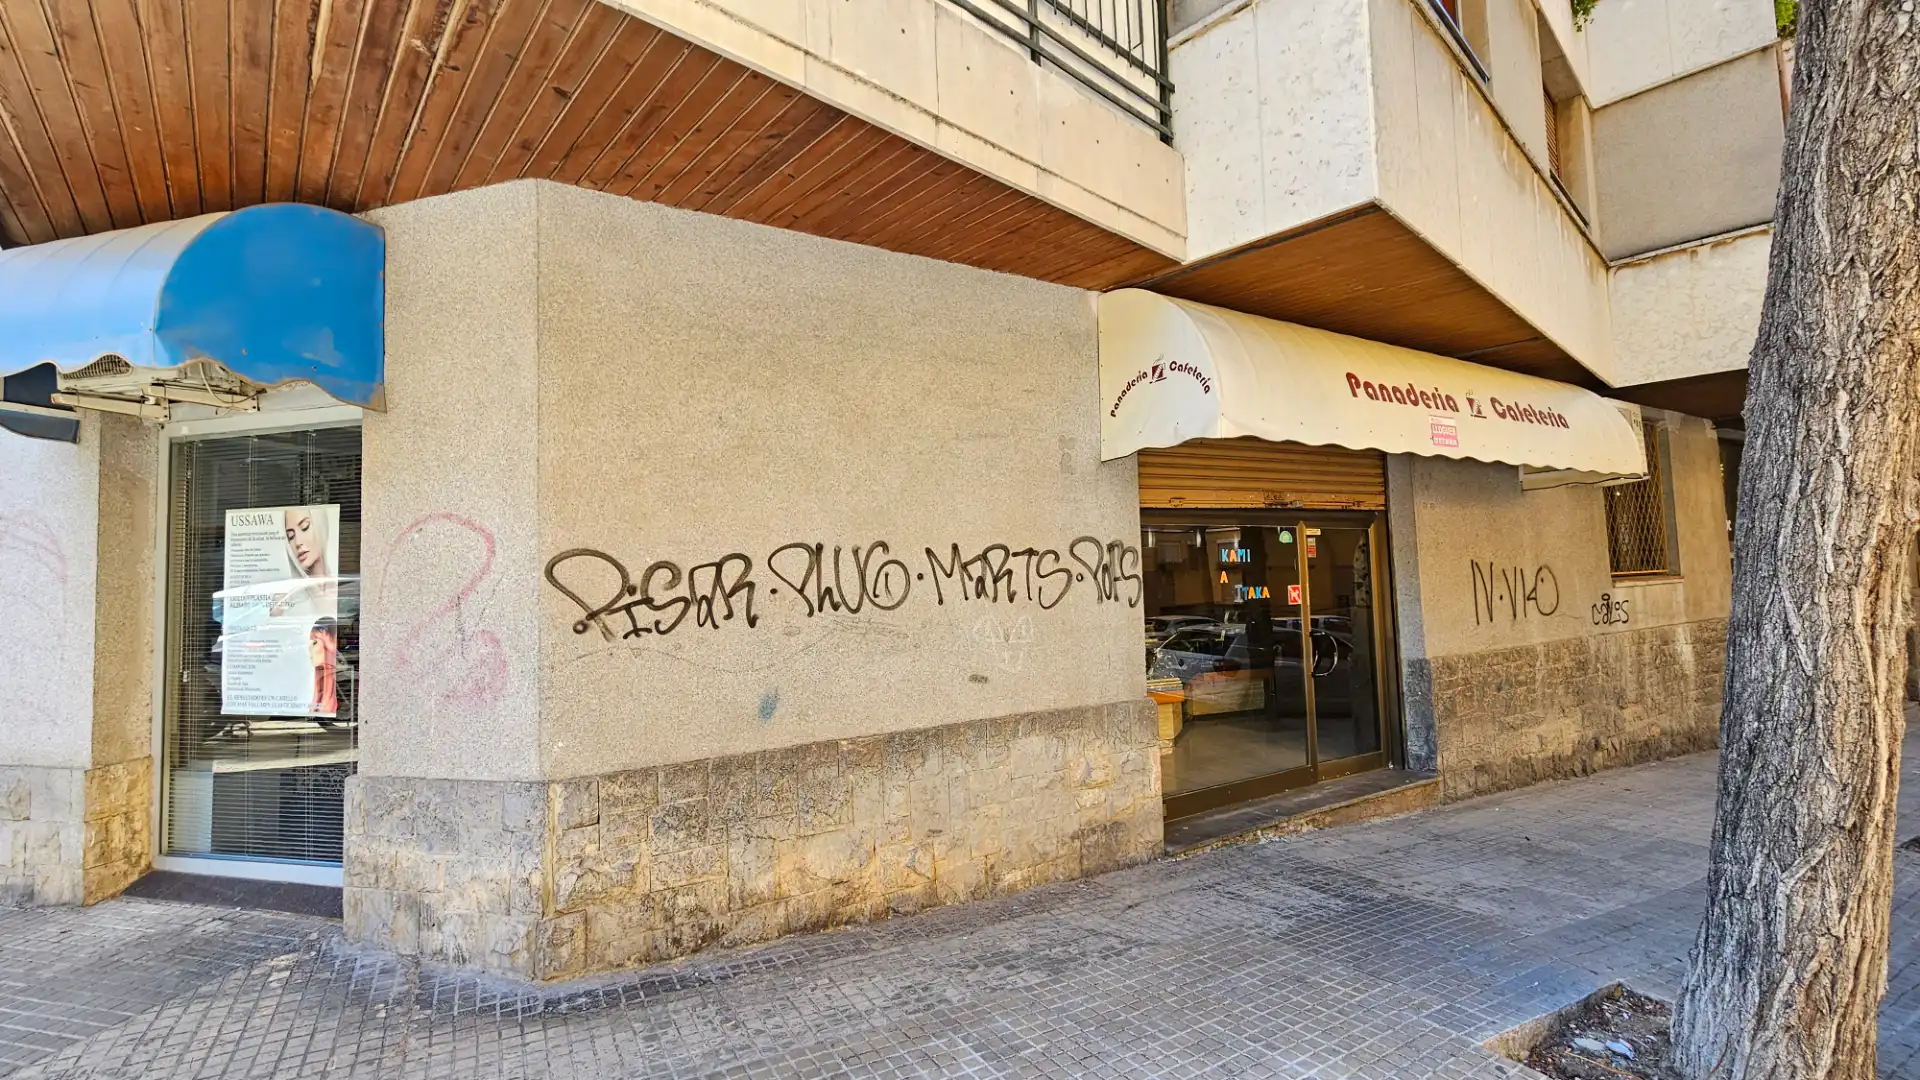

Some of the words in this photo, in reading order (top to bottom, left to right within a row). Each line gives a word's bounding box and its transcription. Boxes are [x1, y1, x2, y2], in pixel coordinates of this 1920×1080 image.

[1110, 370, 1148, 418] Panaderia
[1345, 371, 1460, 413] Panaderia
[1490, 396, 1570, 429] Cafeteria
[231, 513, 274, 527] USSAWA
[1221, 549, 1251, 562] KAMI
[1219, 570, 1229, 584] A
[1233, 584, 1271, 603] ITAKA
